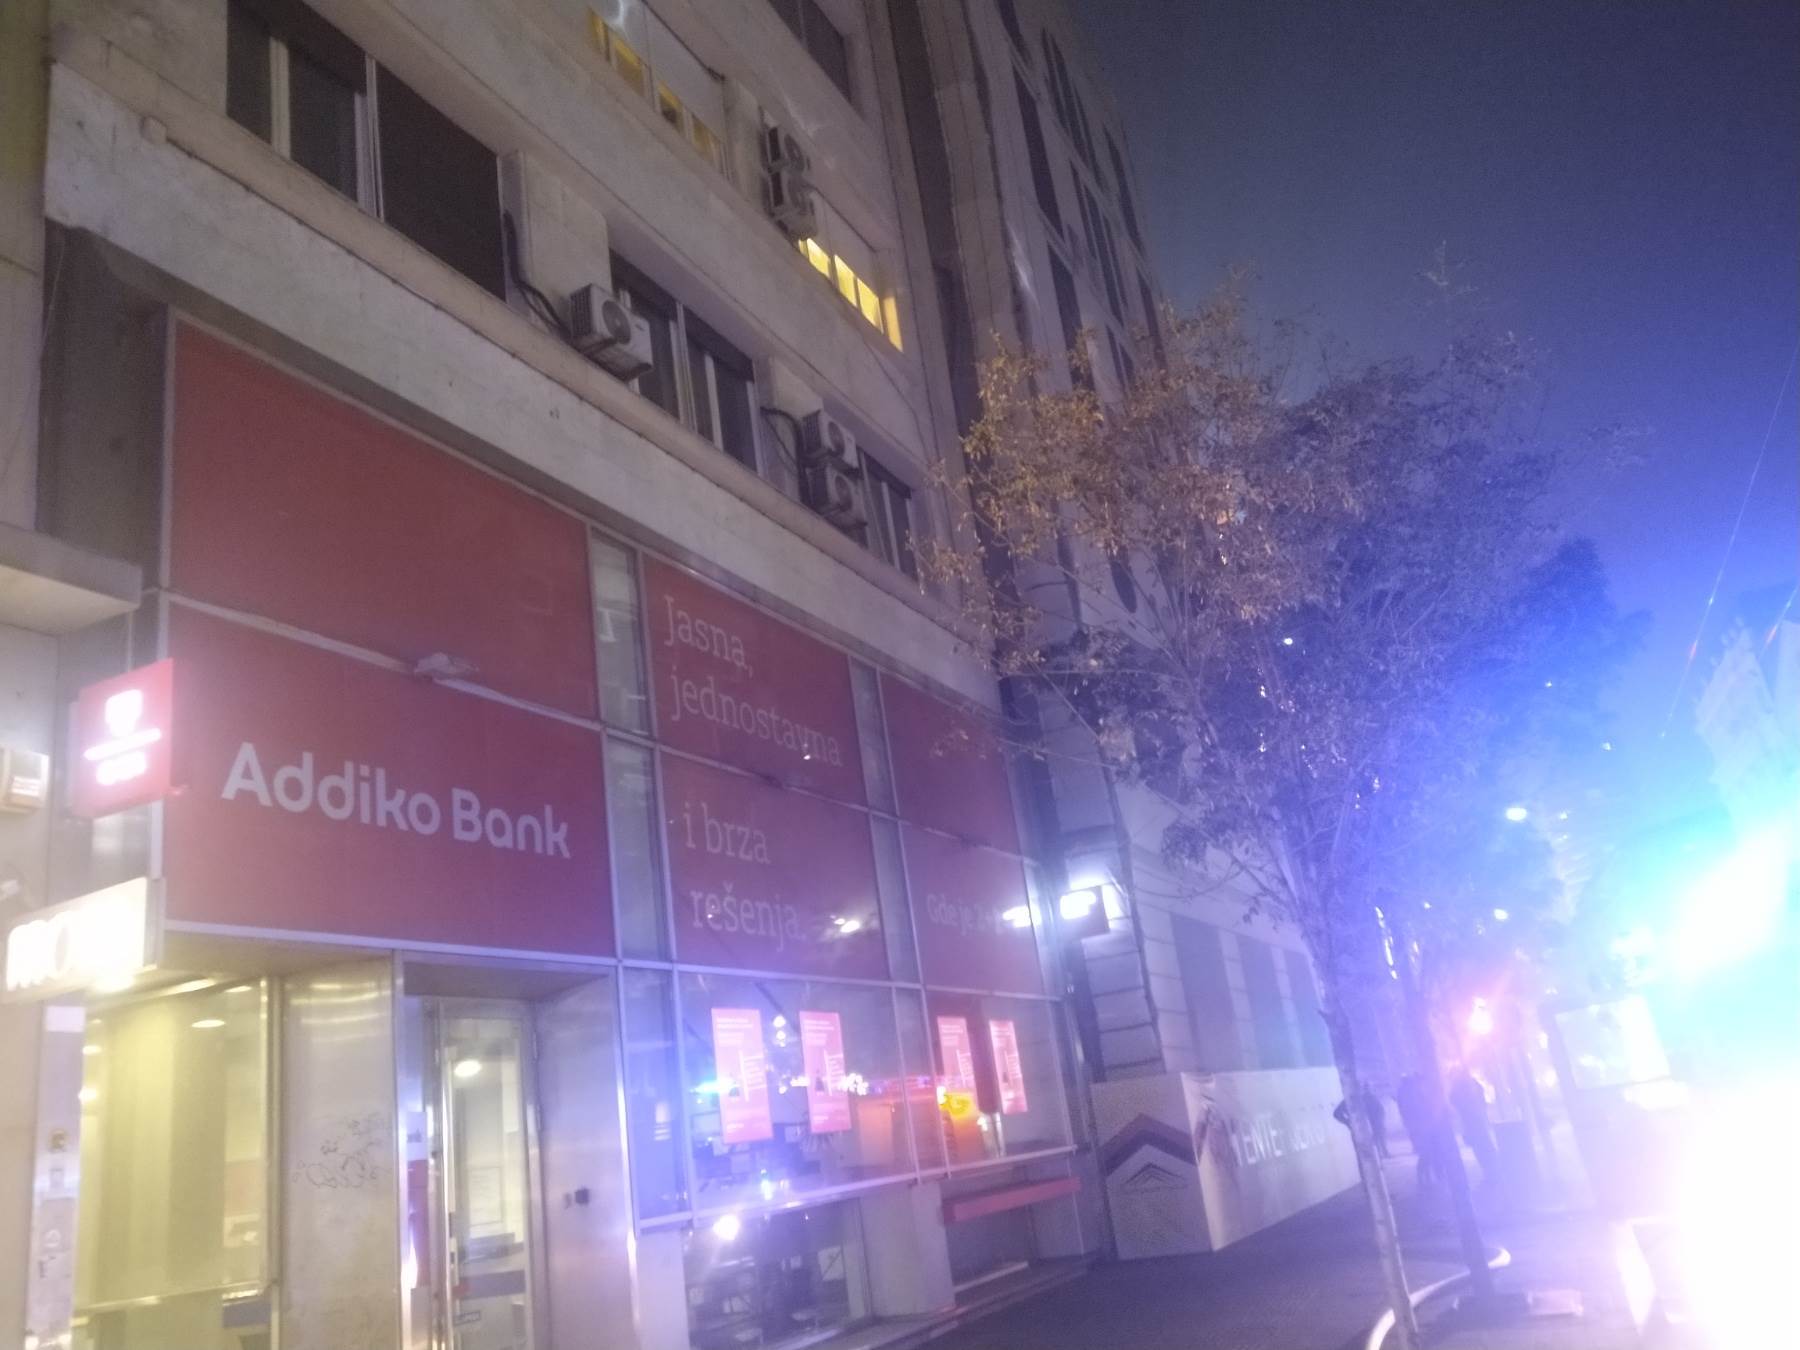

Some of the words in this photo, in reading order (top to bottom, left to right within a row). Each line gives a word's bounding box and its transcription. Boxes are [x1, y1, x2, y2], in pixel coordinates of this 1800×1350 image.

[664, 594, 754, 677] Jasna,
[671, 667, 843, 767] jednostavna
[222, 741, 440, 835] Addiko
[451, 787, 571, 859] Bank
[683, 802, 696, 850] i
[701, 803, 771, 864] brza
